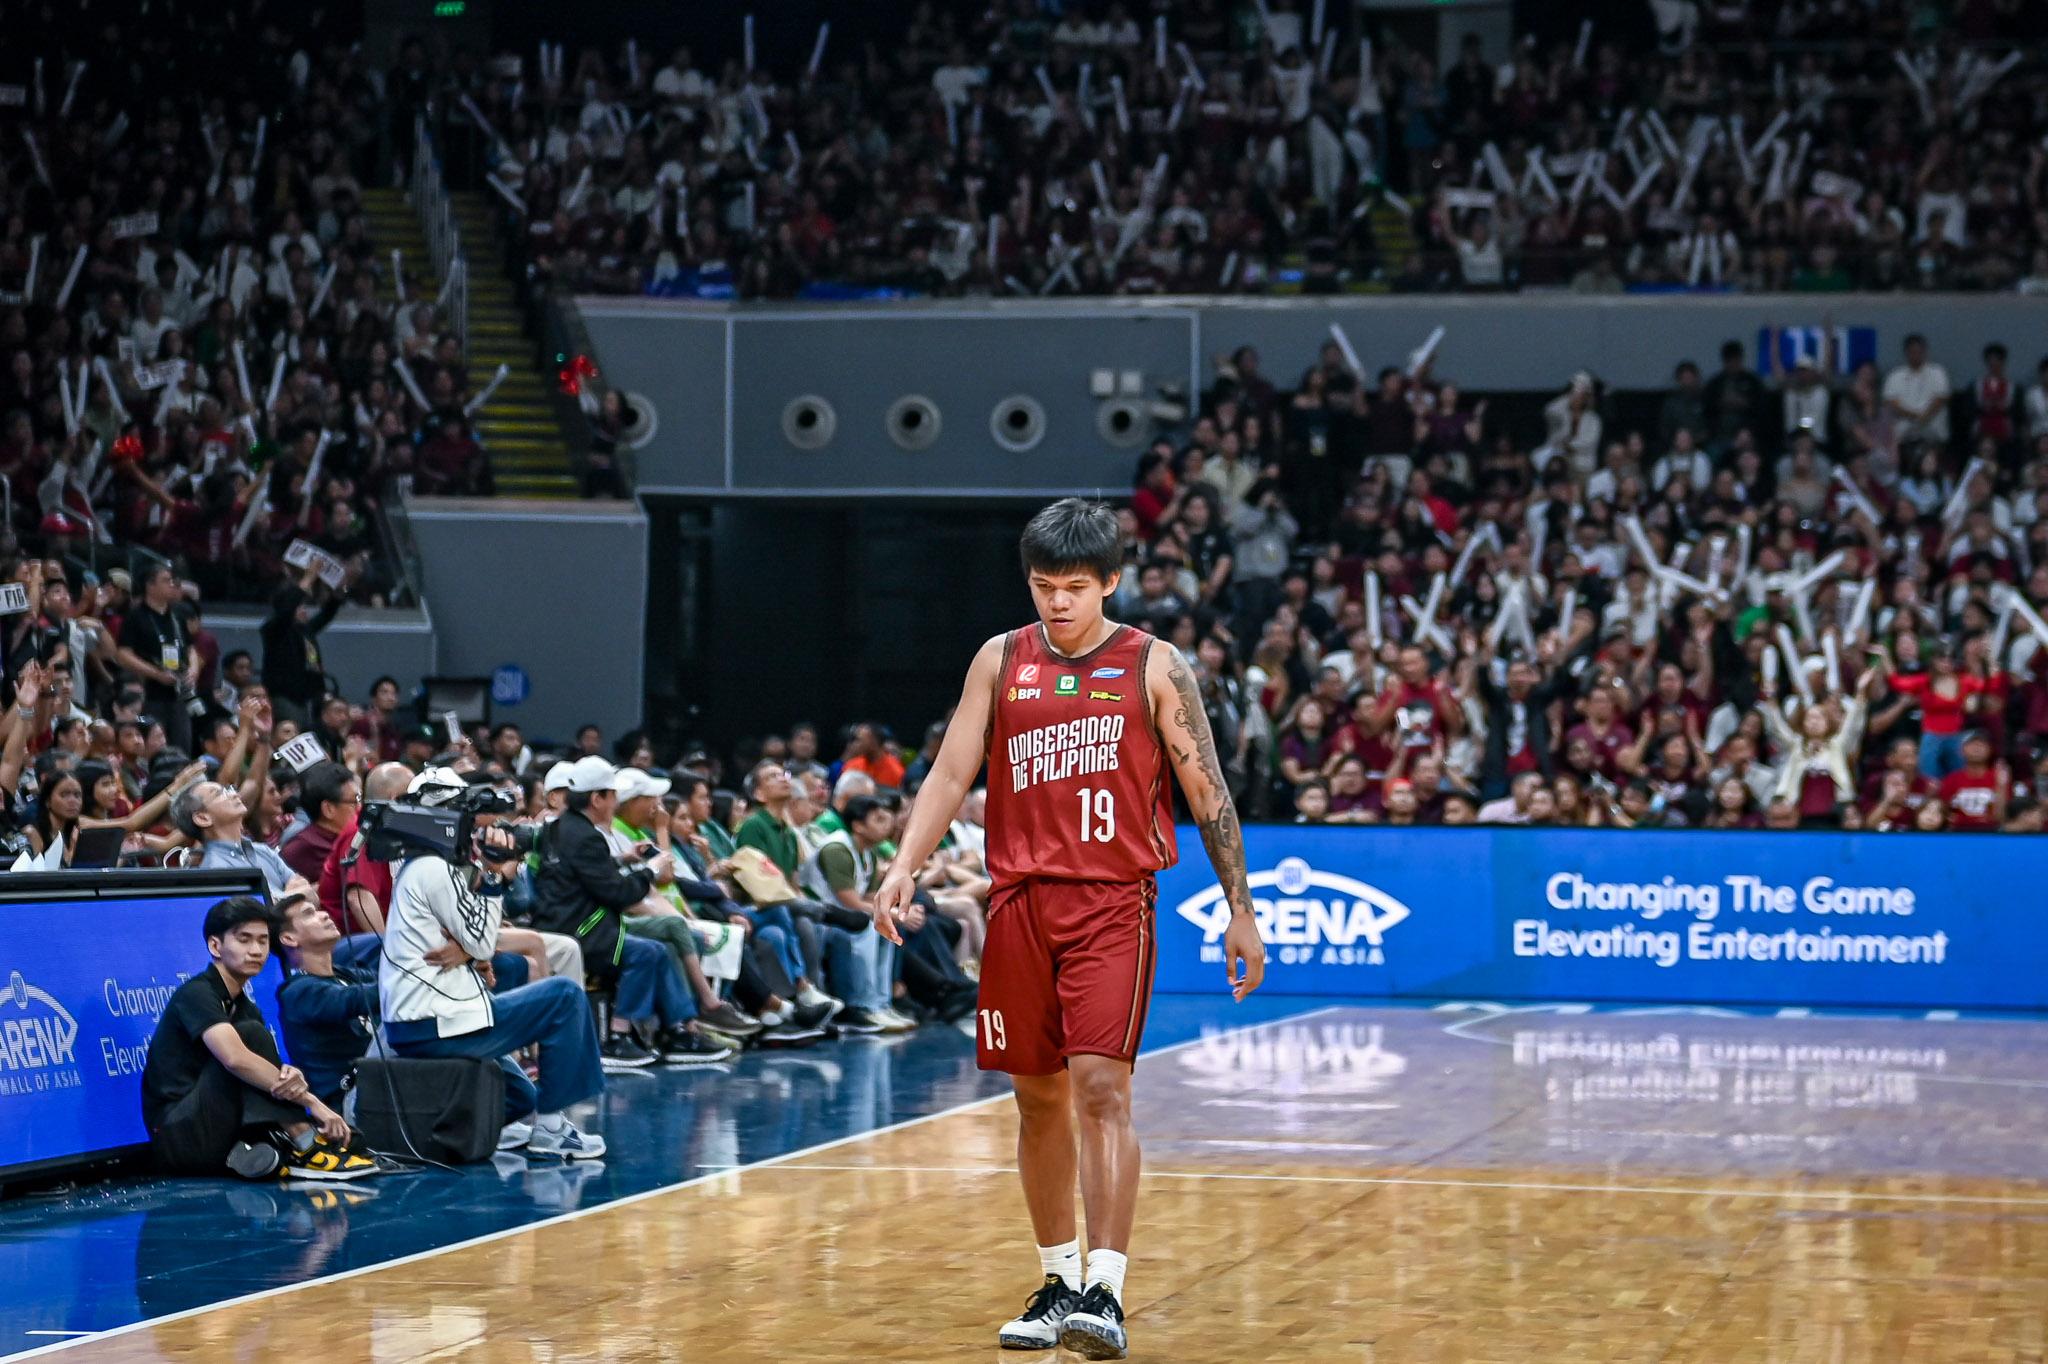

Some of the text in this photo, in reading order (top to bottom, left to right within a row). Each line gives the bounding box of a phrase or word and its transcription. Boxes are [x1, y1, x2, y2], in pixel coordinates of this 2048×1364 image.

[1018, 688, 1041, 700] BPI
[1008, 715, 1124, 765] UNIBERSIDAD
[1012, 743, 1119, 794] NG PILIPINAS
[1076, 787, 1115, 843] 19
[1546, 872, 1916, 920] Changing The Game
[1279, 946, 1314, 965] OF
[1321, 946, 1385, 966] ASIA
[1513, 919, 1948, 967] Elevating Entertainment
[979, 1009, 1006, 1050] 19
[100, 1034, 153, 1077] Eleva
[0, 1068, 81, 1097] MALL OF ASIA
